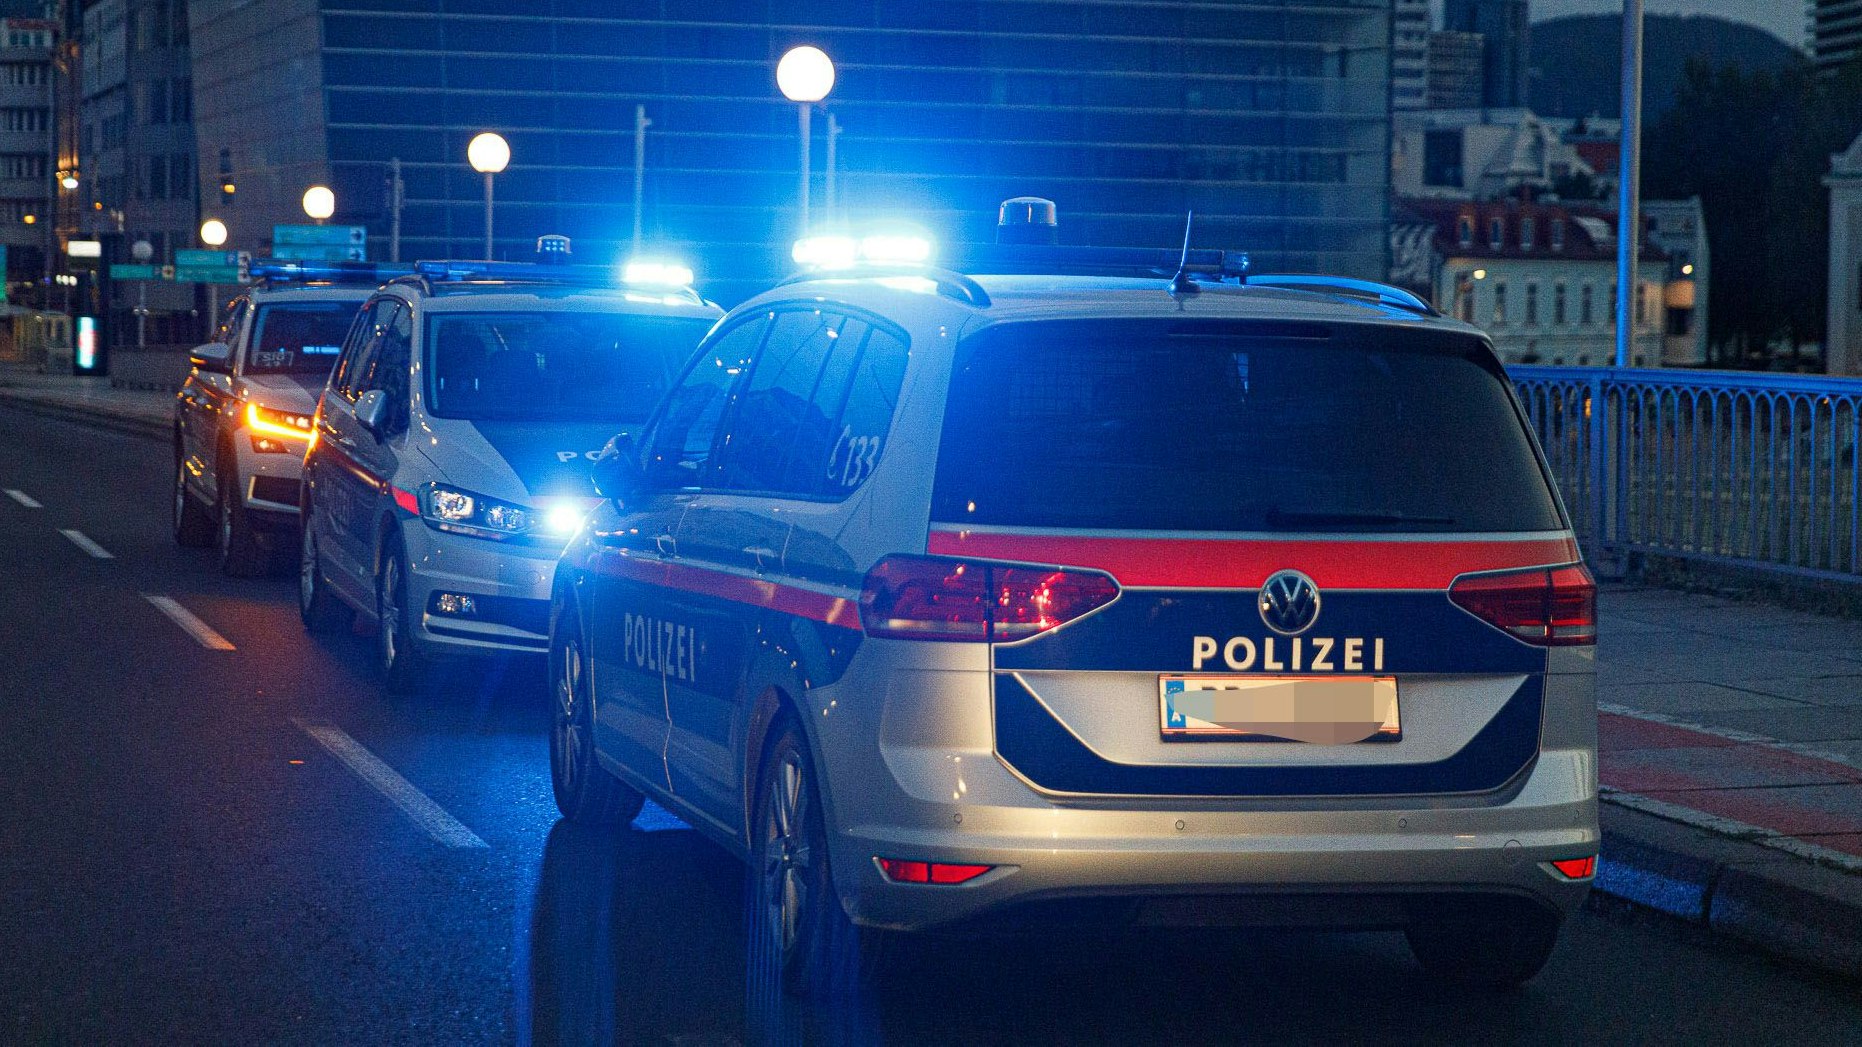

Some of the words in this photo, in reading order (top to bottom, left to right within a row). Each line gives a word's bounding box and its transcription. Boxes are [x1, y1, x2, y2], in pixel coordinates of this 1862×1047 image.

[556, 450, 603, 462] PO
[841, 436, 880, 486] 133
[624, 612, 695, 682] POLIZEI
[1192, 635, 1384, 671] POLIZEI
[1171, 711, 1182, 722] A
